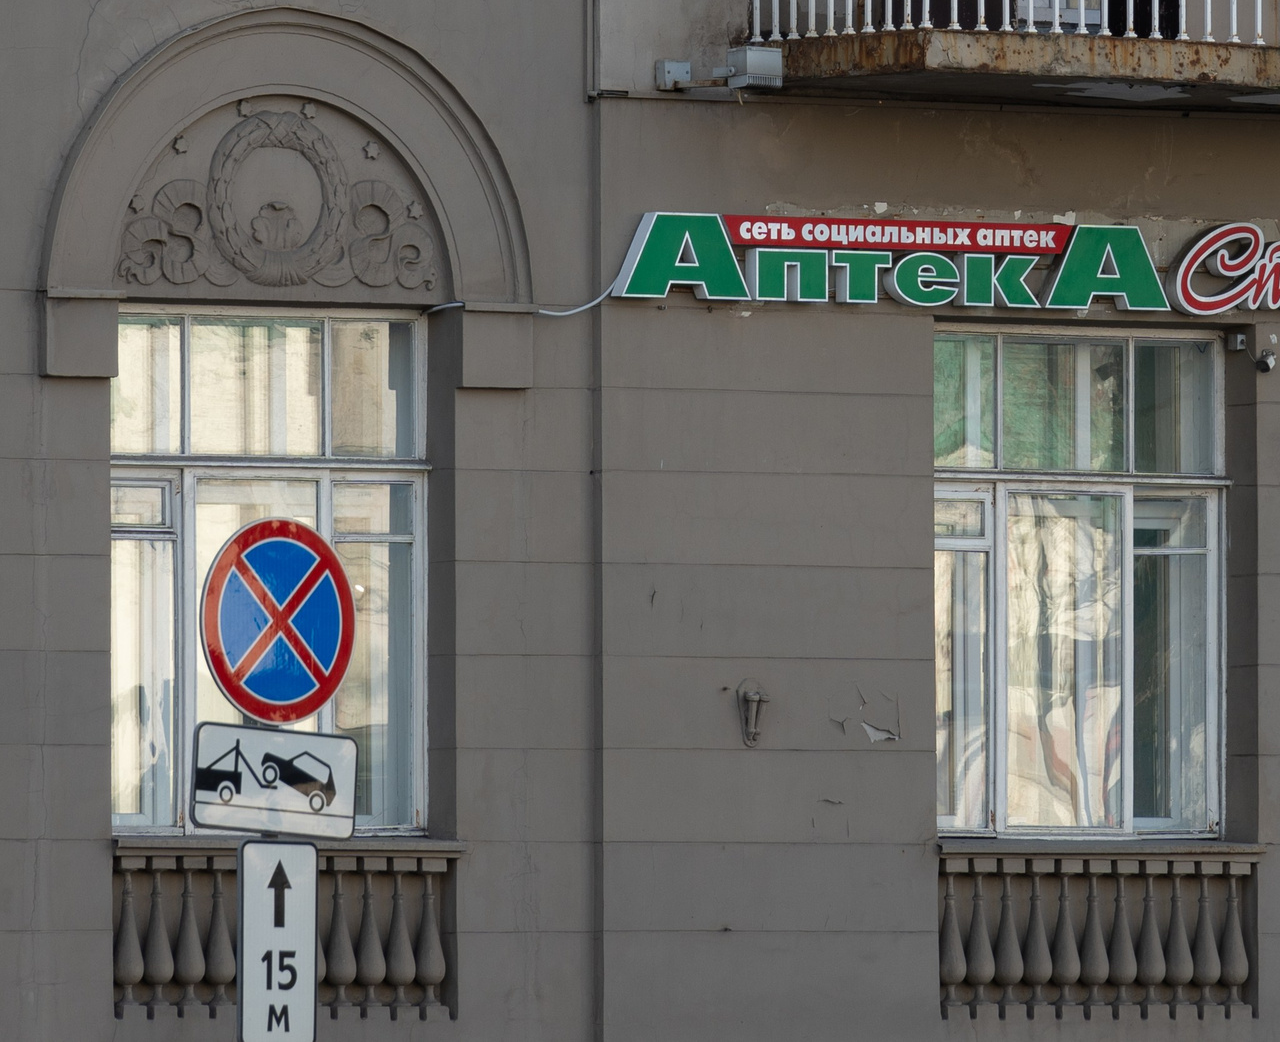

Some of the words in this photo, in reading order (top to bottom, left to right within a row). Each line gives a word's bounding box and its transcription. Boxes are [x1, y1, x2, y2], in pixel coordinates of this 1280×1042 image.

[739, 220, 796, 240] сеть
[801, 222, 972, 245] социальных
[976, 227, 1056, 249] аптек
[261, 949, 298, 992] 15
